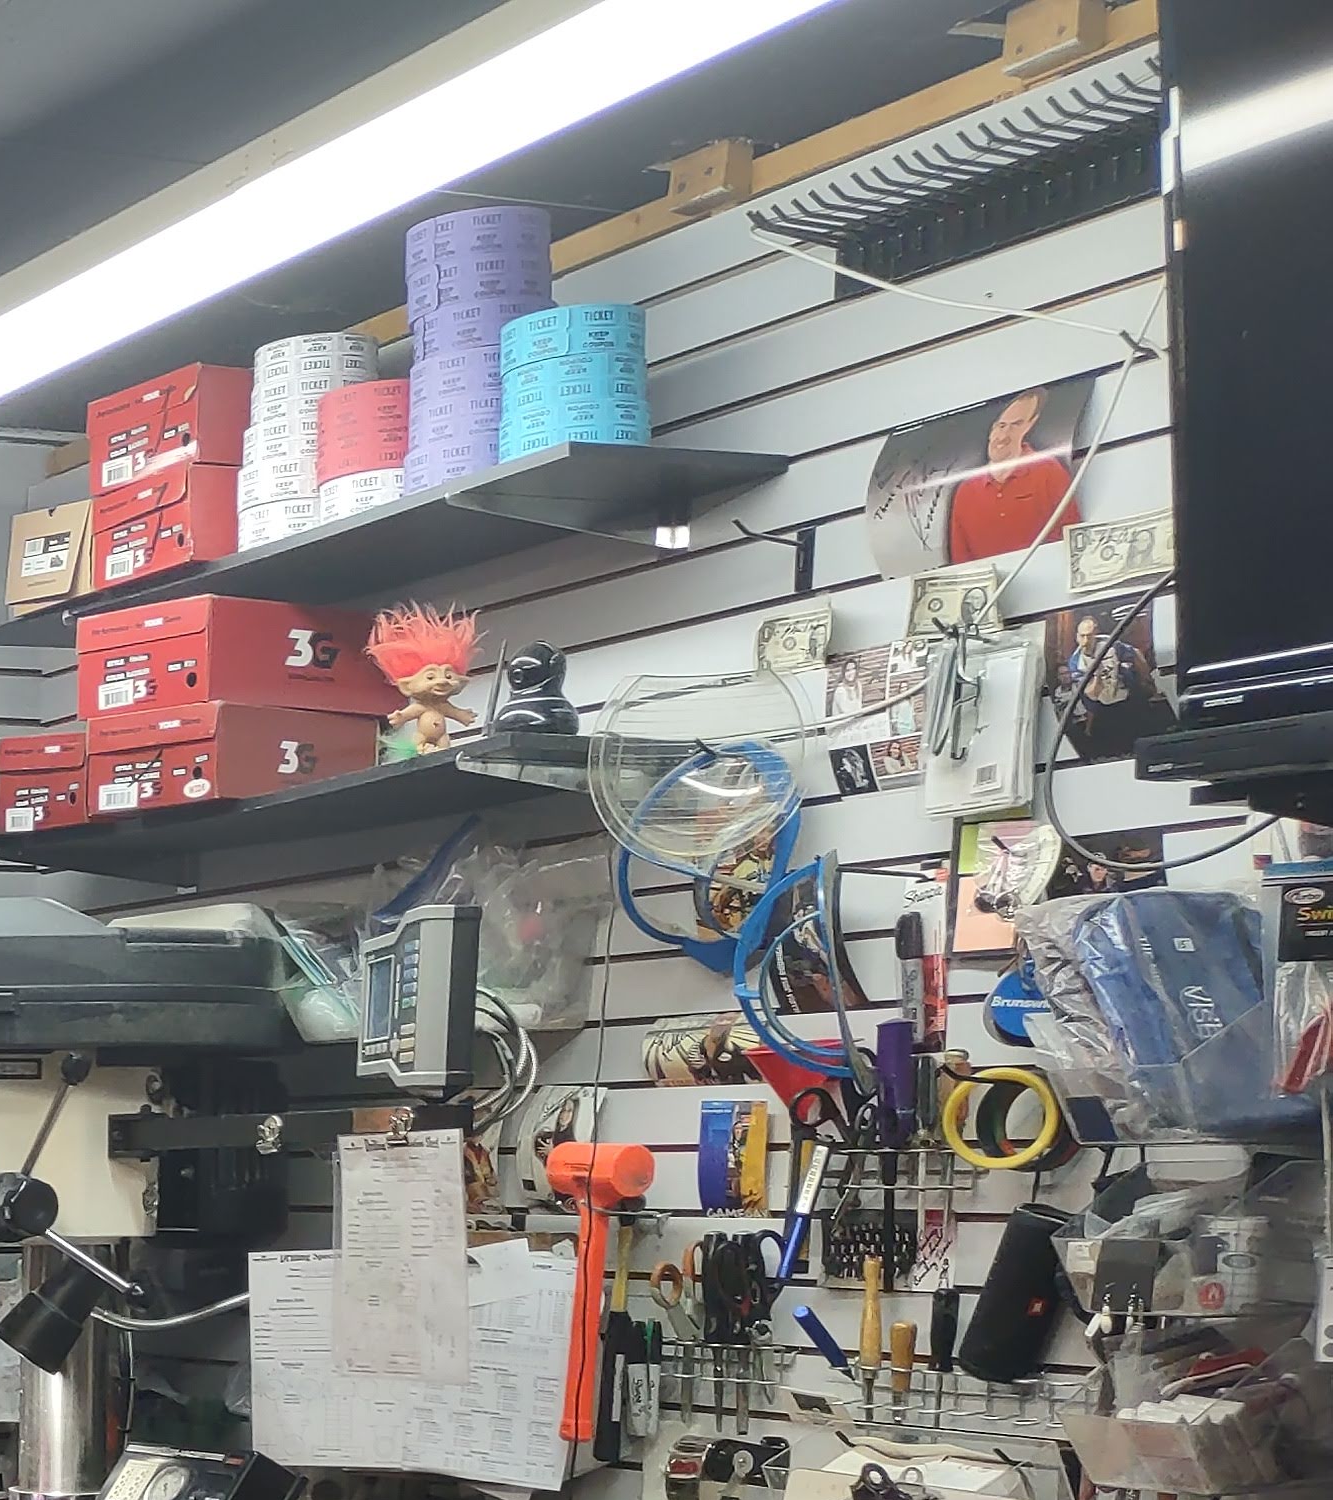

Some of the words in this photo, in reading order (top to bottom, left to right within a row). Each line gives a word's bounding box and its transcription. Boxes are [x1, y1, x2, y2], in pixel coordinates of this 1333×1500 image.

[473, 214, 501, 225] TICKET
[437, 221, 454, 232] CKET
[476, 260, 504, 272] TICKET
[441, 267, 457, 278] CKET
[453, 308, 480, 321] TICKET
[584, 311, 614, 321] TICKET
[529, 316, 557, 331] TICKET
[303, 359, 331, 371] TICKET
[439, 357, 466, 370] TICKET
[264, 386, 286, 397] TICKET
[301, 380, 328, 391] TICKET
[560, 384, 591, 396] TICKET
[471, 398, 500, 410] TICKET
[429, 404, 453, 417] TICKET
[263, 425, 287, 436] TICKET
[443, 446, 471, 459] TICKET
[272, 463, 299, 474] TICKET
[352, 477, 379, 488] TICKET
[284, 504, 312, 515] TICKET
[285, 629, 340, 669] 3G
[277, 740, 317, 774] 3G
